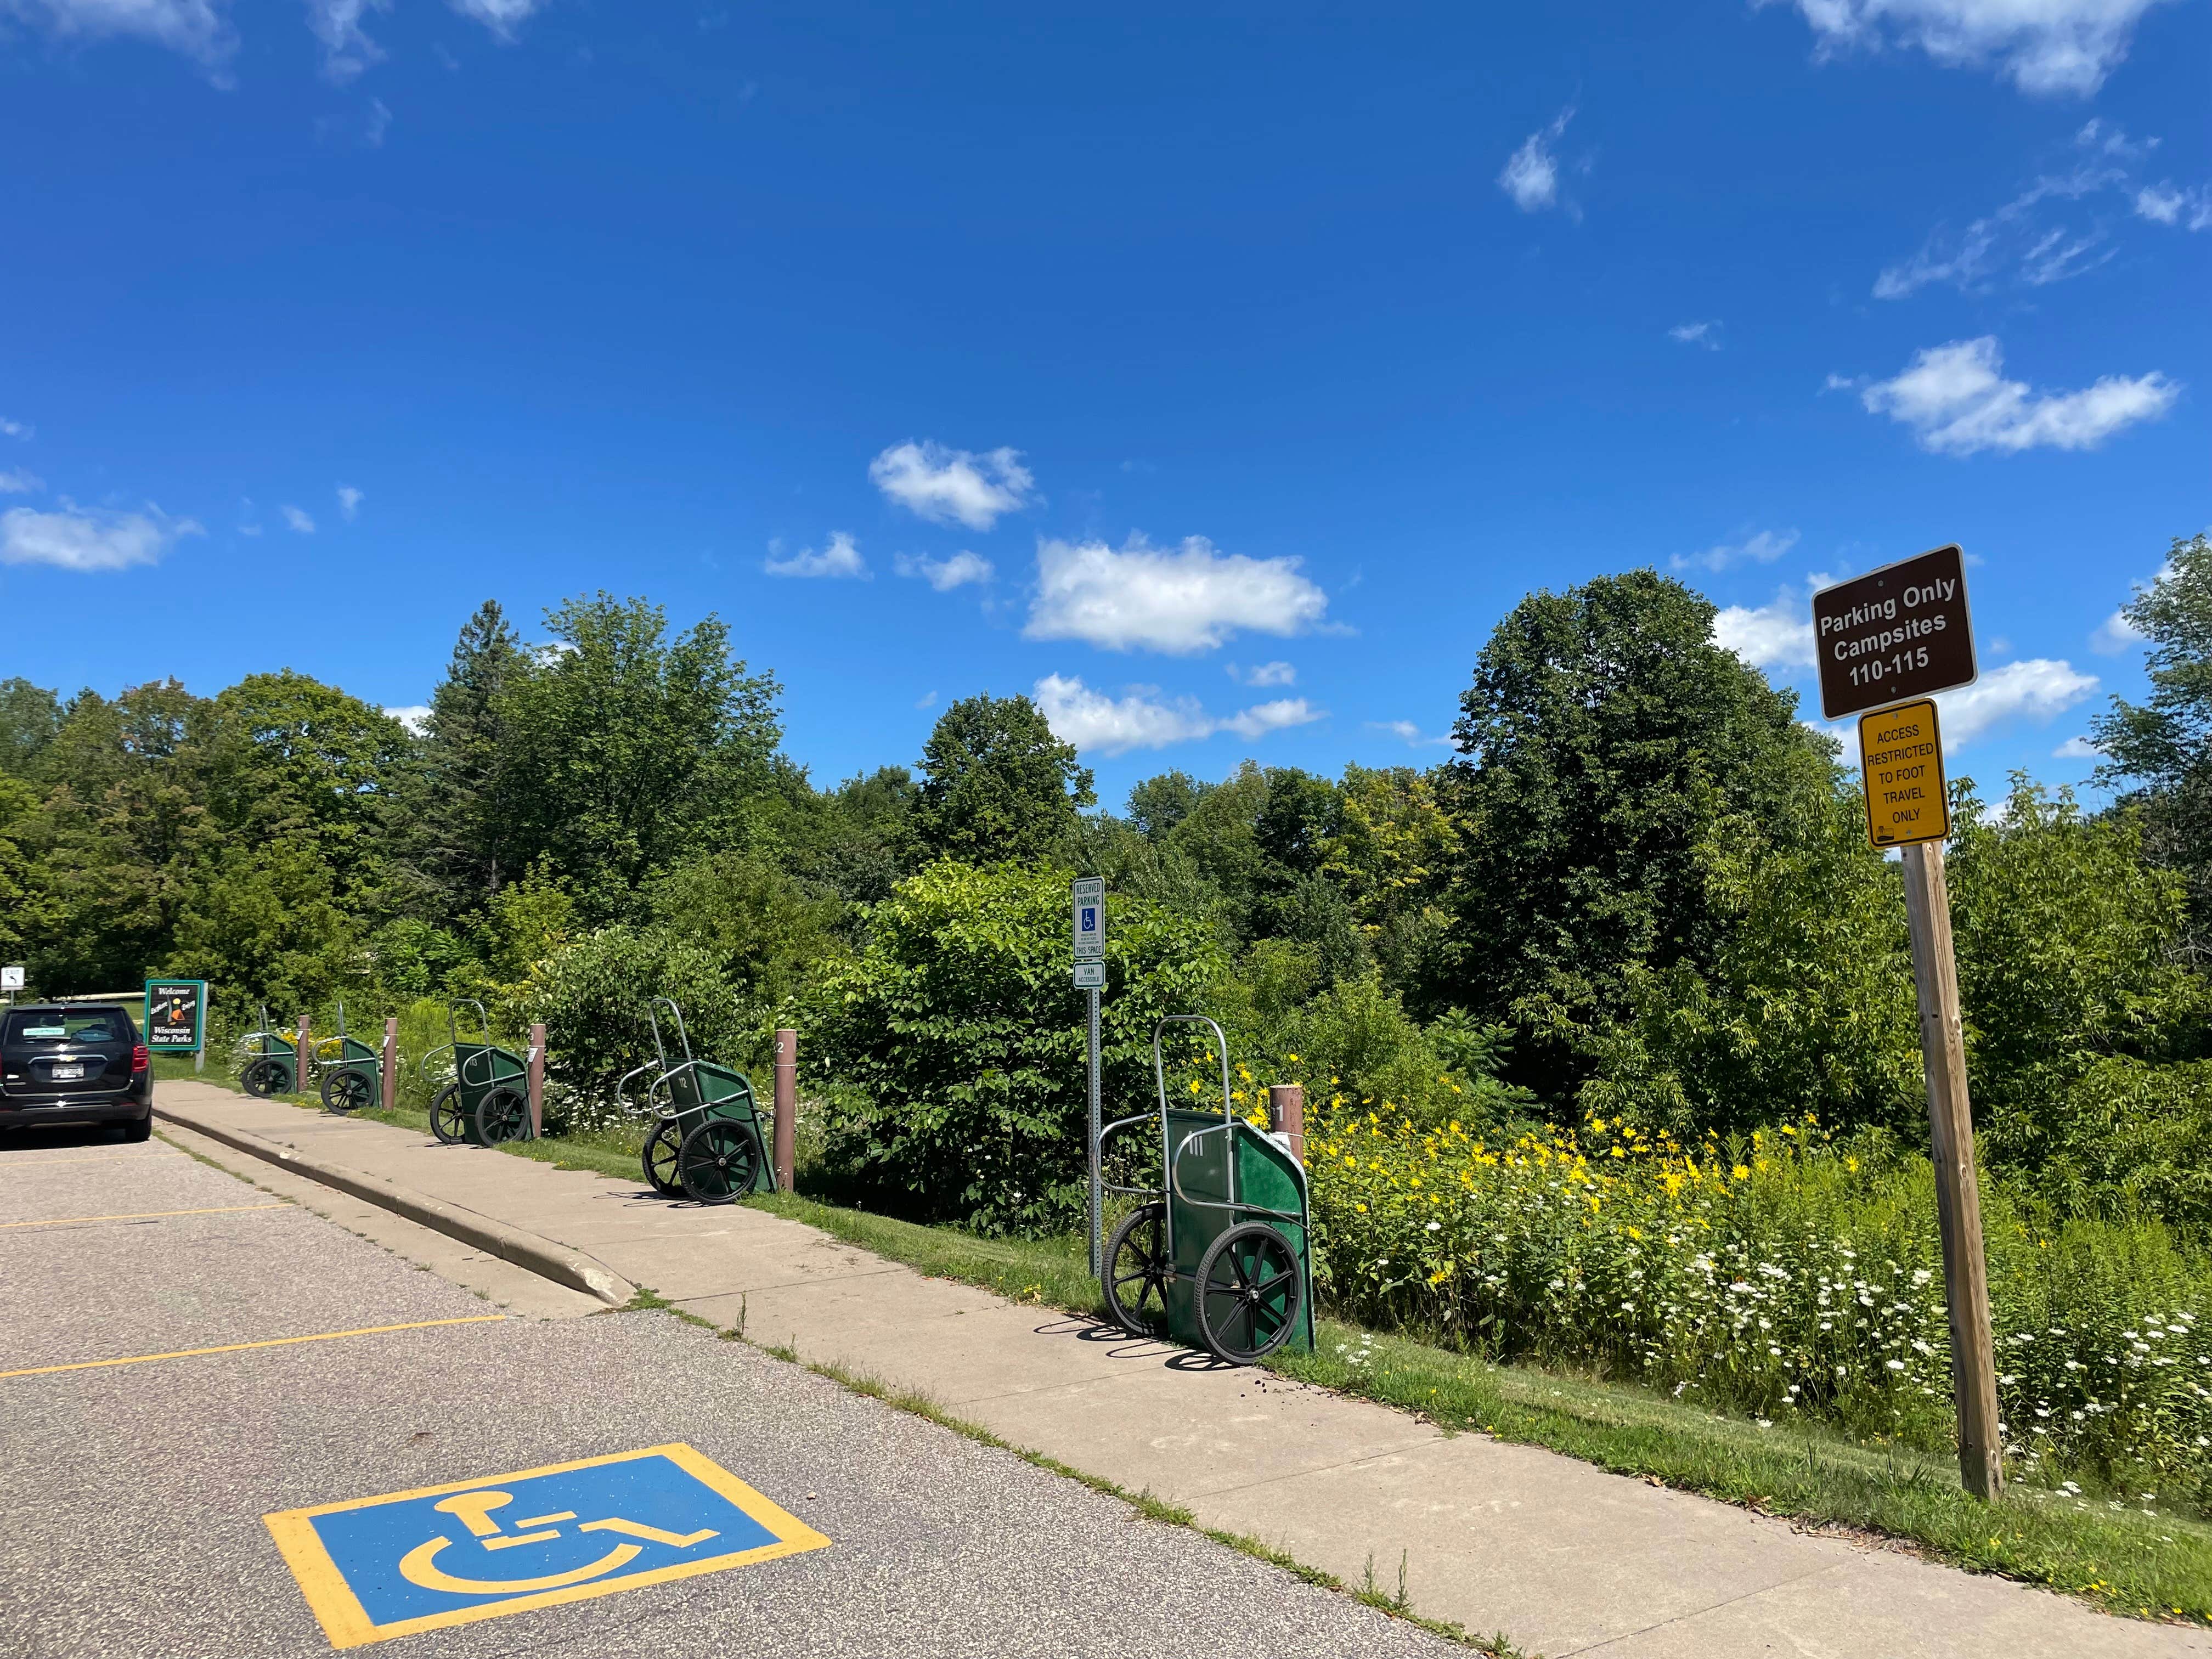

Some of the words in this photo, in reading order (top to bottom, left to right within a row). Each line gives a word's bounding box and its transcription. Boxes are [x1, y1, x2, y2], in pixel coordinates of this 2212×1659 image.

[1820, 598, 1896, 636] Parking
[1903, 578, 1955, 608] Only
[1834, 614, 1946, 661] Campsites
[1849, 646, 1928, 686] 110-115
[1877, 724, 1919, 744] ACCESS
[1867, 743, 1934, 766] RESTRICTED
[1879, 772, 1893, 785] TO
[1897, 765, 1925, 782] FOOT
[1883, 787, 1925, 804] TRAVEL
[1892, 808, 1920, 823] ONLY
[1076, 883, 1100, 894] RESERVED
[1077, 895, 1099, 907] PARKING
[1088, 945, 1101, 954] SPACE
